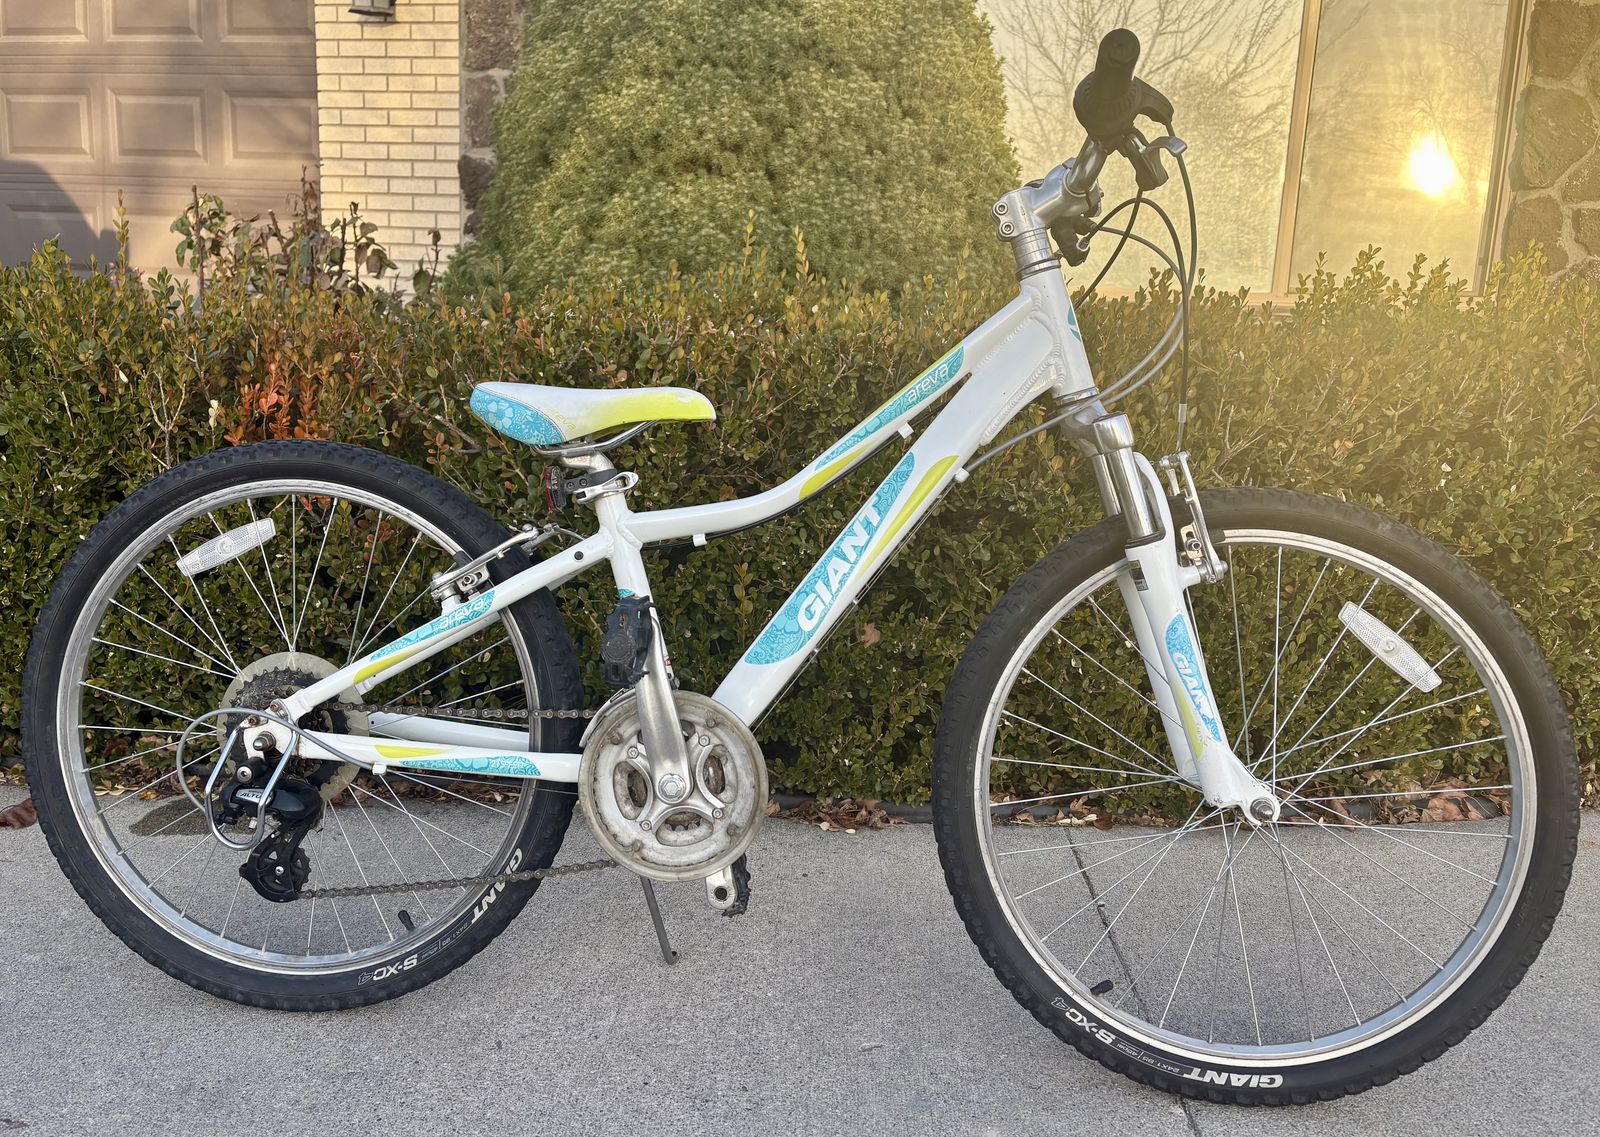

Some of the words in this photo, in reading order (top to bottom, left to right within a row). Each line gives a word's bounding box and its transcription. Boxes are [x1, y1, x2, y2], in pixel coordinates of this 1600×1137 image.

[907, 363, 949, 403] areva
[797, 496, 883, 633] GIANT
[440, 598, 485, 629] areva
[239, 791, 261, 799] ALTU
[1183, 1067, 1284, 1089] GIANT
